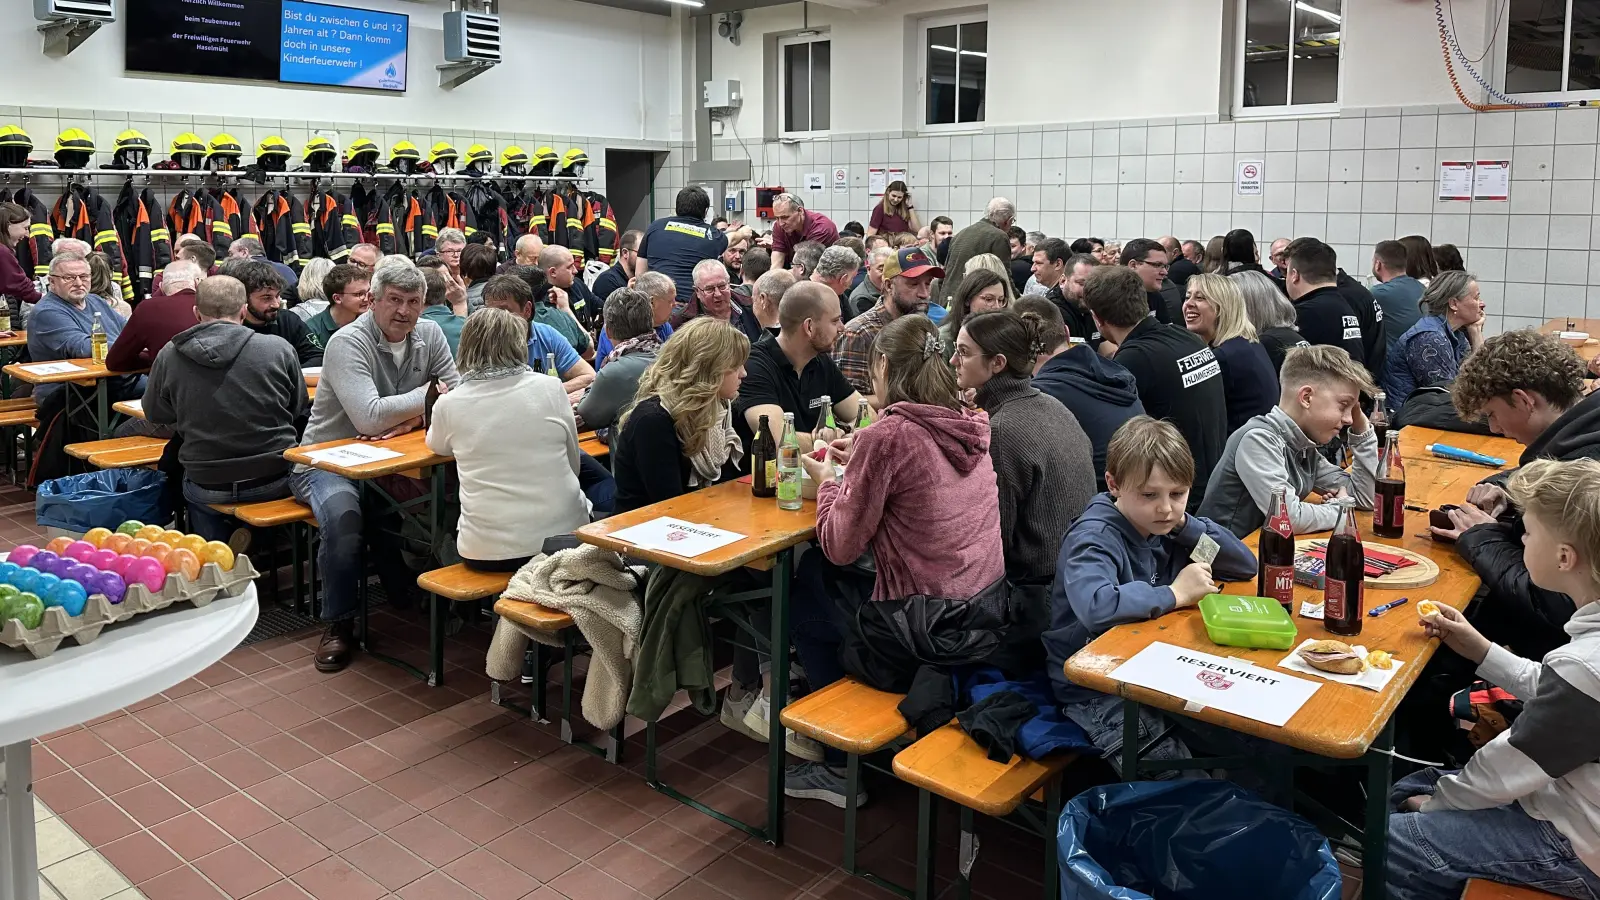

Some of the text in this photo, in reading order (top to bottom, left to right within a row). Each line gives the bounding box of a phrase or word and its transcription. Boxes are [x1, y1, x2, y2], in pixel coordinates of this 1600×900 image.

[201, 17, 241, 27] Taubenmarkt
[284, 10, 403, 32] Bist du zwischen 6 und 12
[184, 34, 219, 43] Freiwilligen
[220, 37, 251, 46] Feuerwehr
[284, 24, 391, 44] Jahren alt ? Dann komm
[196, 44, 228, 52] Haselmühl
[284, 39, 351, 54] doch in unsere
[283, 53, 363, 68] Kinderfeuerwehr !
[666, 523, 721, 538] RESERVIERT
[1176, 655, 1280, 686] RESERVIERT
